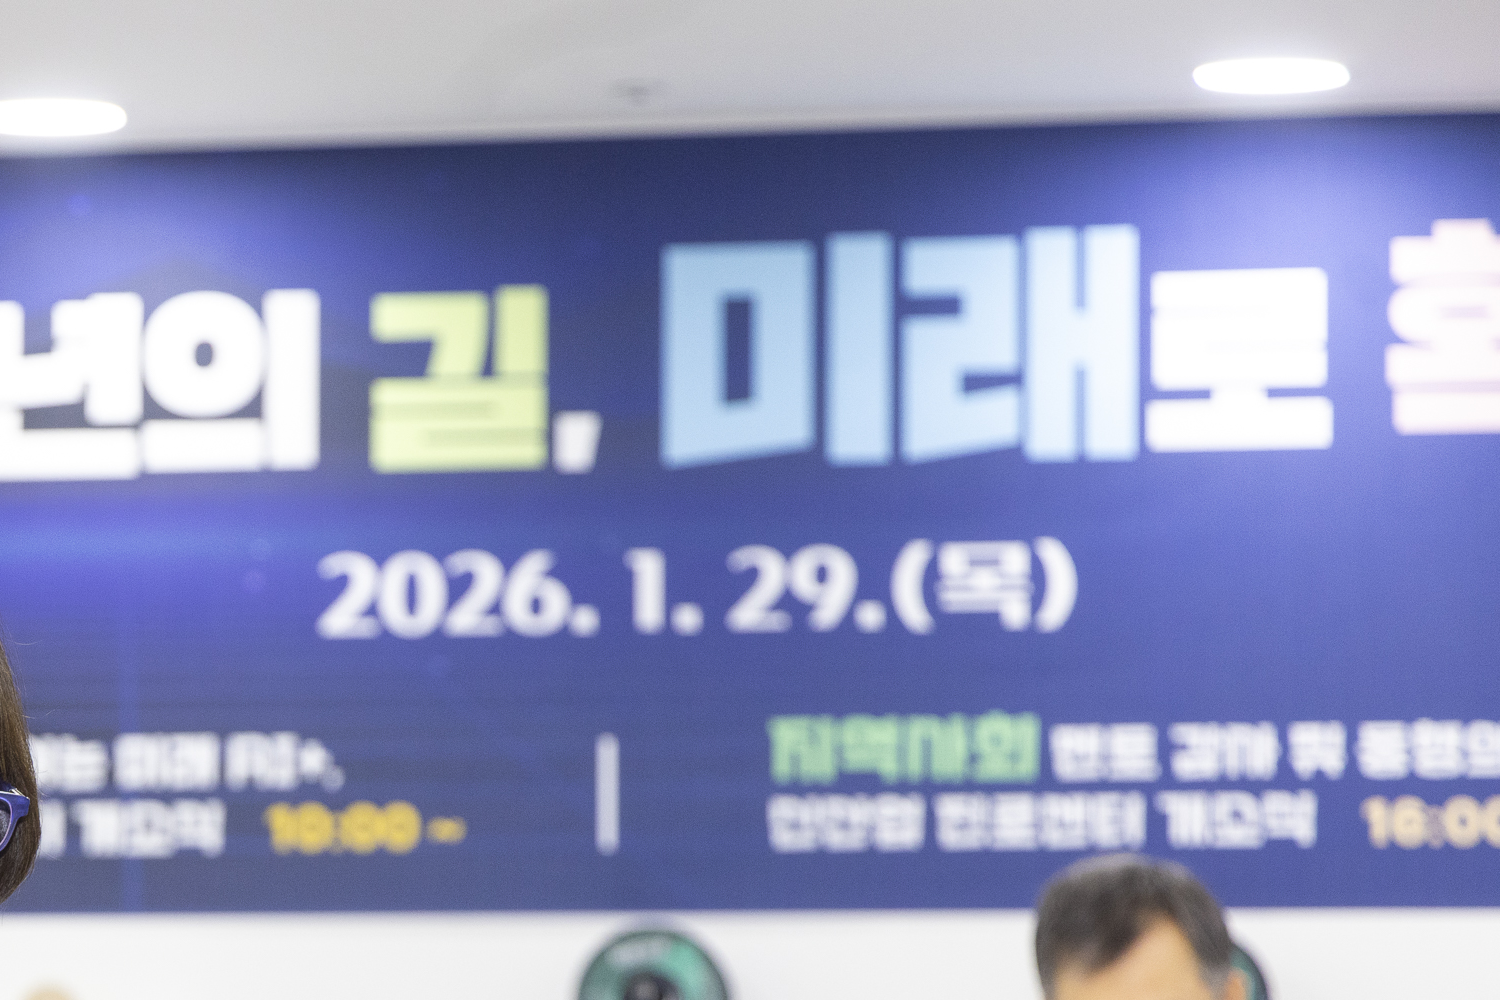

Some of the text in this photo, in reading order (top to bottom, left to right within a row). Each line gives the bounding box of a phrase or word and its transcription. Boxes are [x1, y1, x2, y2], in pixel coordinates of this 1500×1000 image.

[370, 284, 602, 475] 길,
[660, 223, 1335, 470] 미래로
[317, 535, 1080, 641] 2026. 1. 29.(목)
[767, 712, 1042, 786] 지역사회
